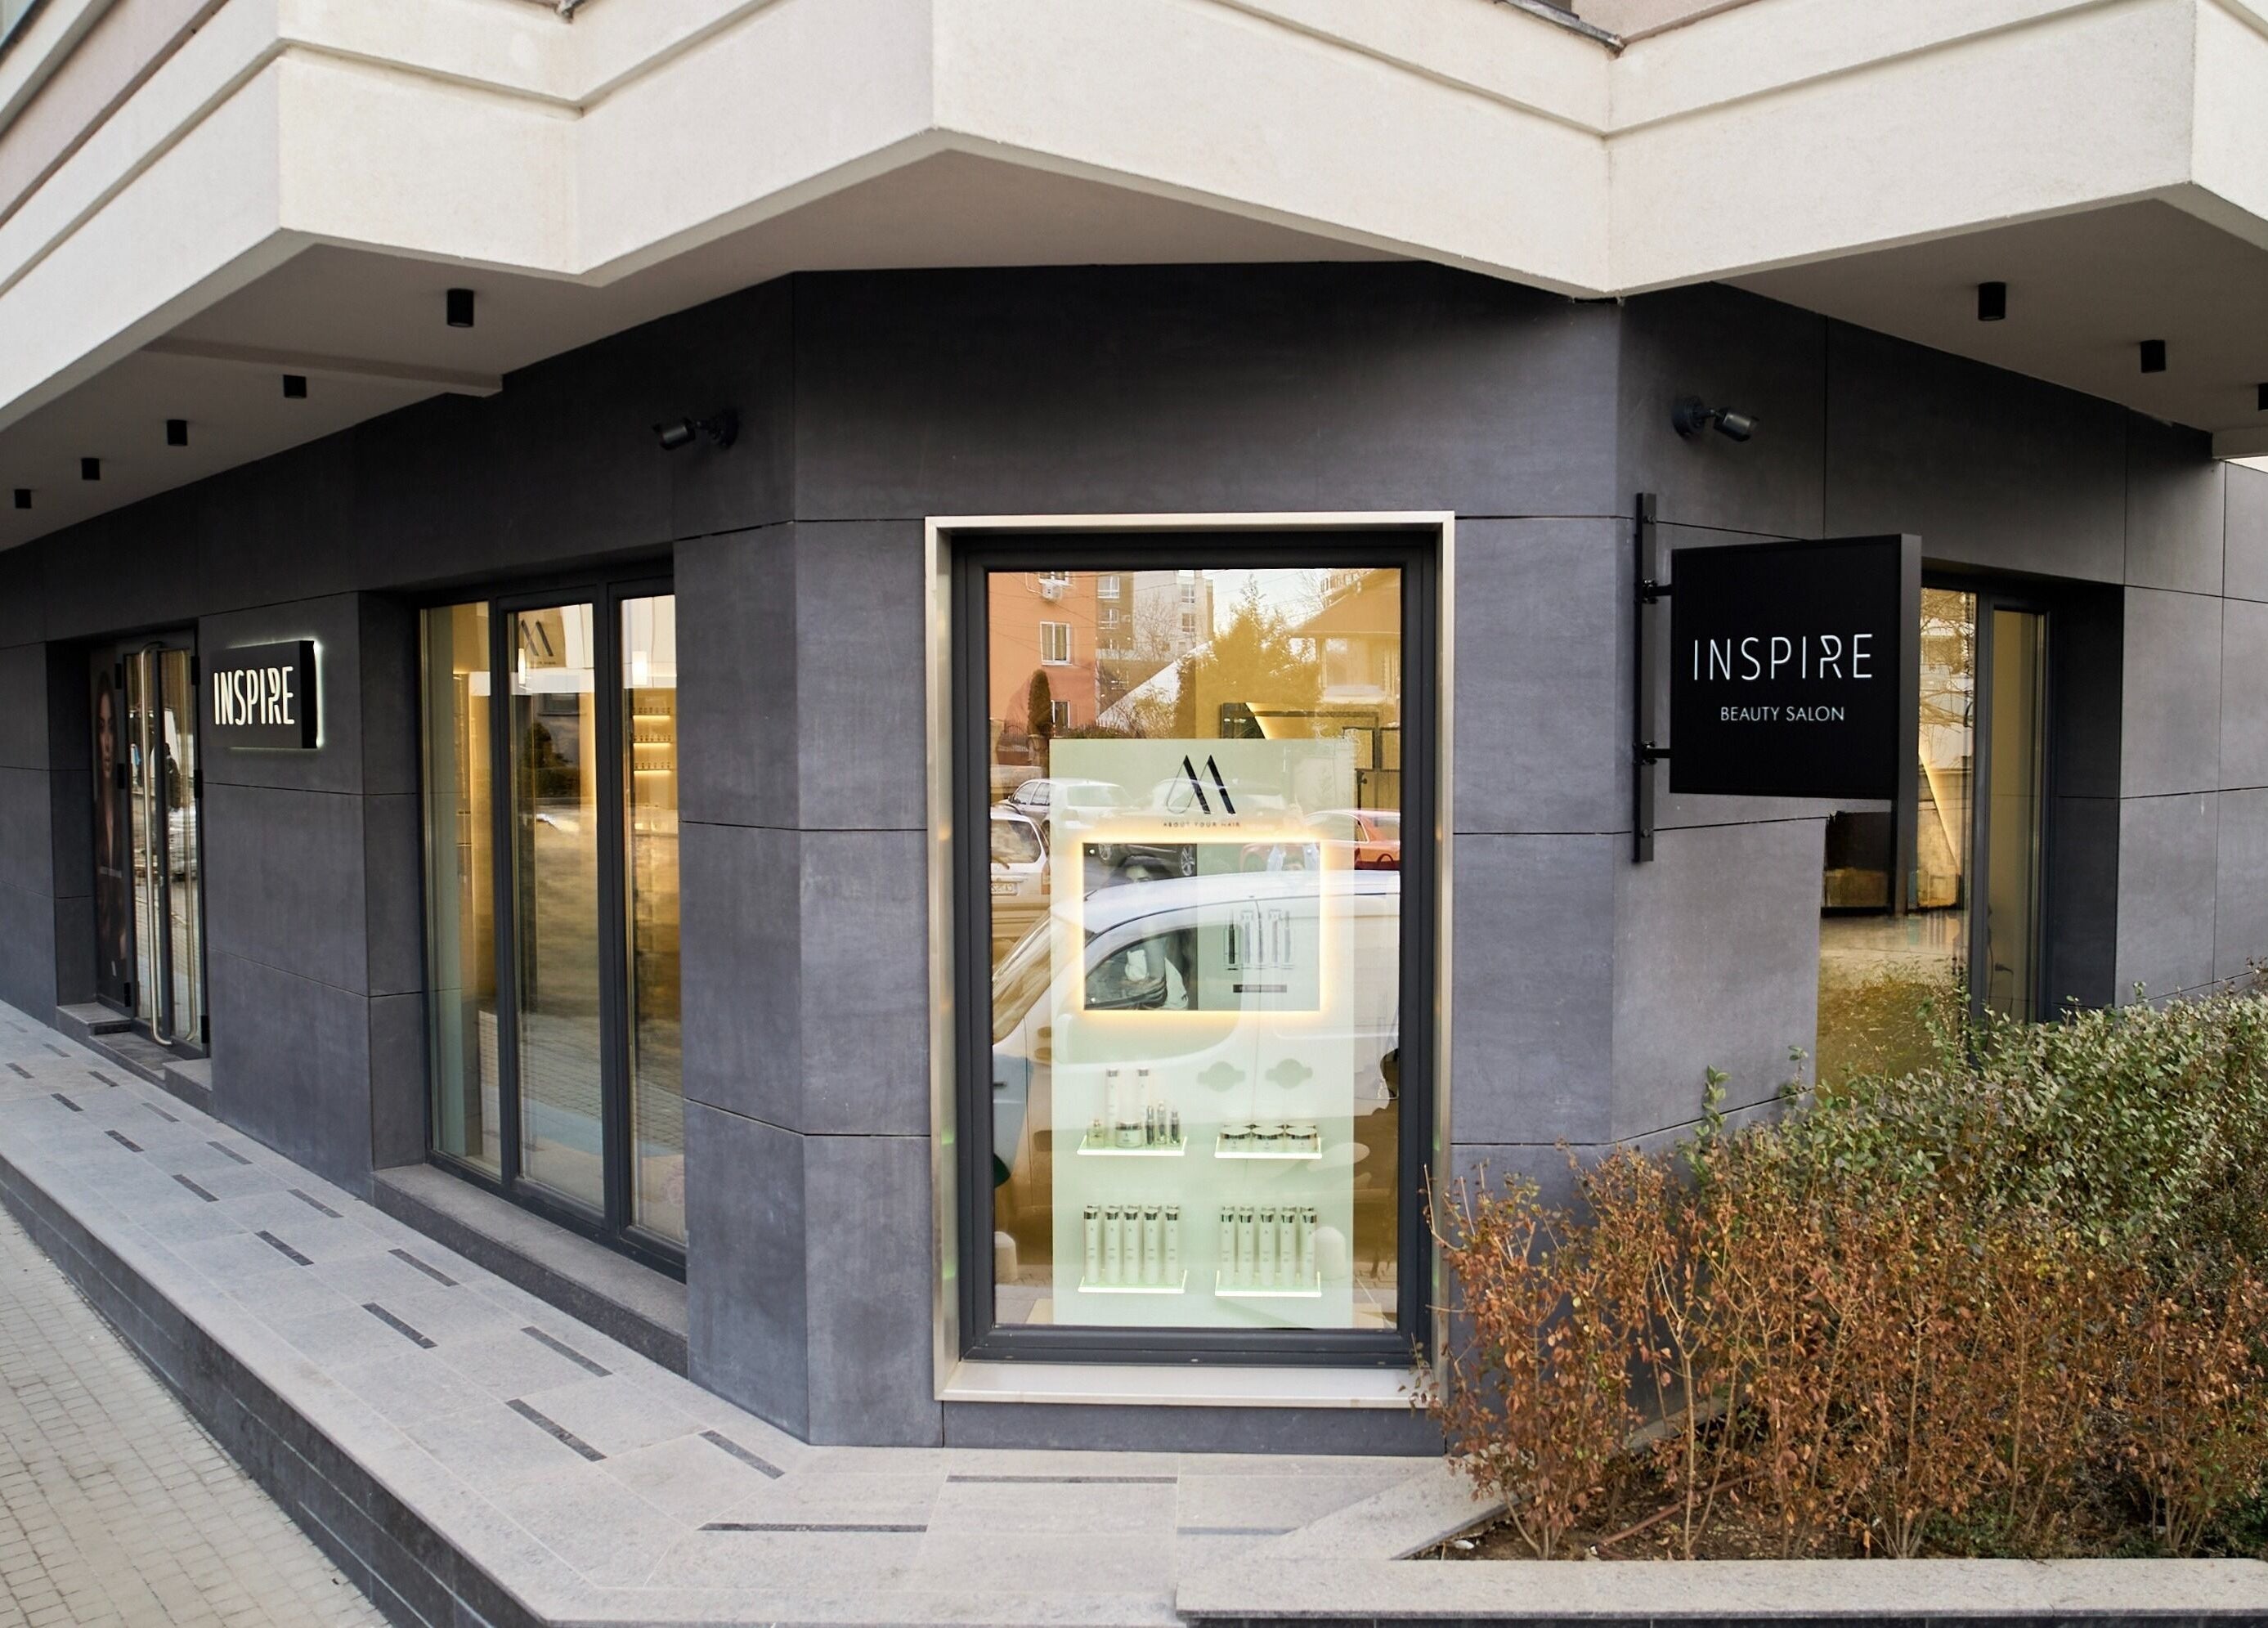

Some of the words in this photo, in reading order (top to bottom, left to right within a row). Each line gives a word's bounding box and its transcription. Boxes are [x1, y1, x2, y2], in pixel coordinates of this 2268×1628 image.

[1693, 633, 1873, 681] INSPIRE
[213, 666, 295, 726] INSPIRE
[1720, 706, 1780, 721] BEAUTY
[1786, 706, 1844, 721] SALON
